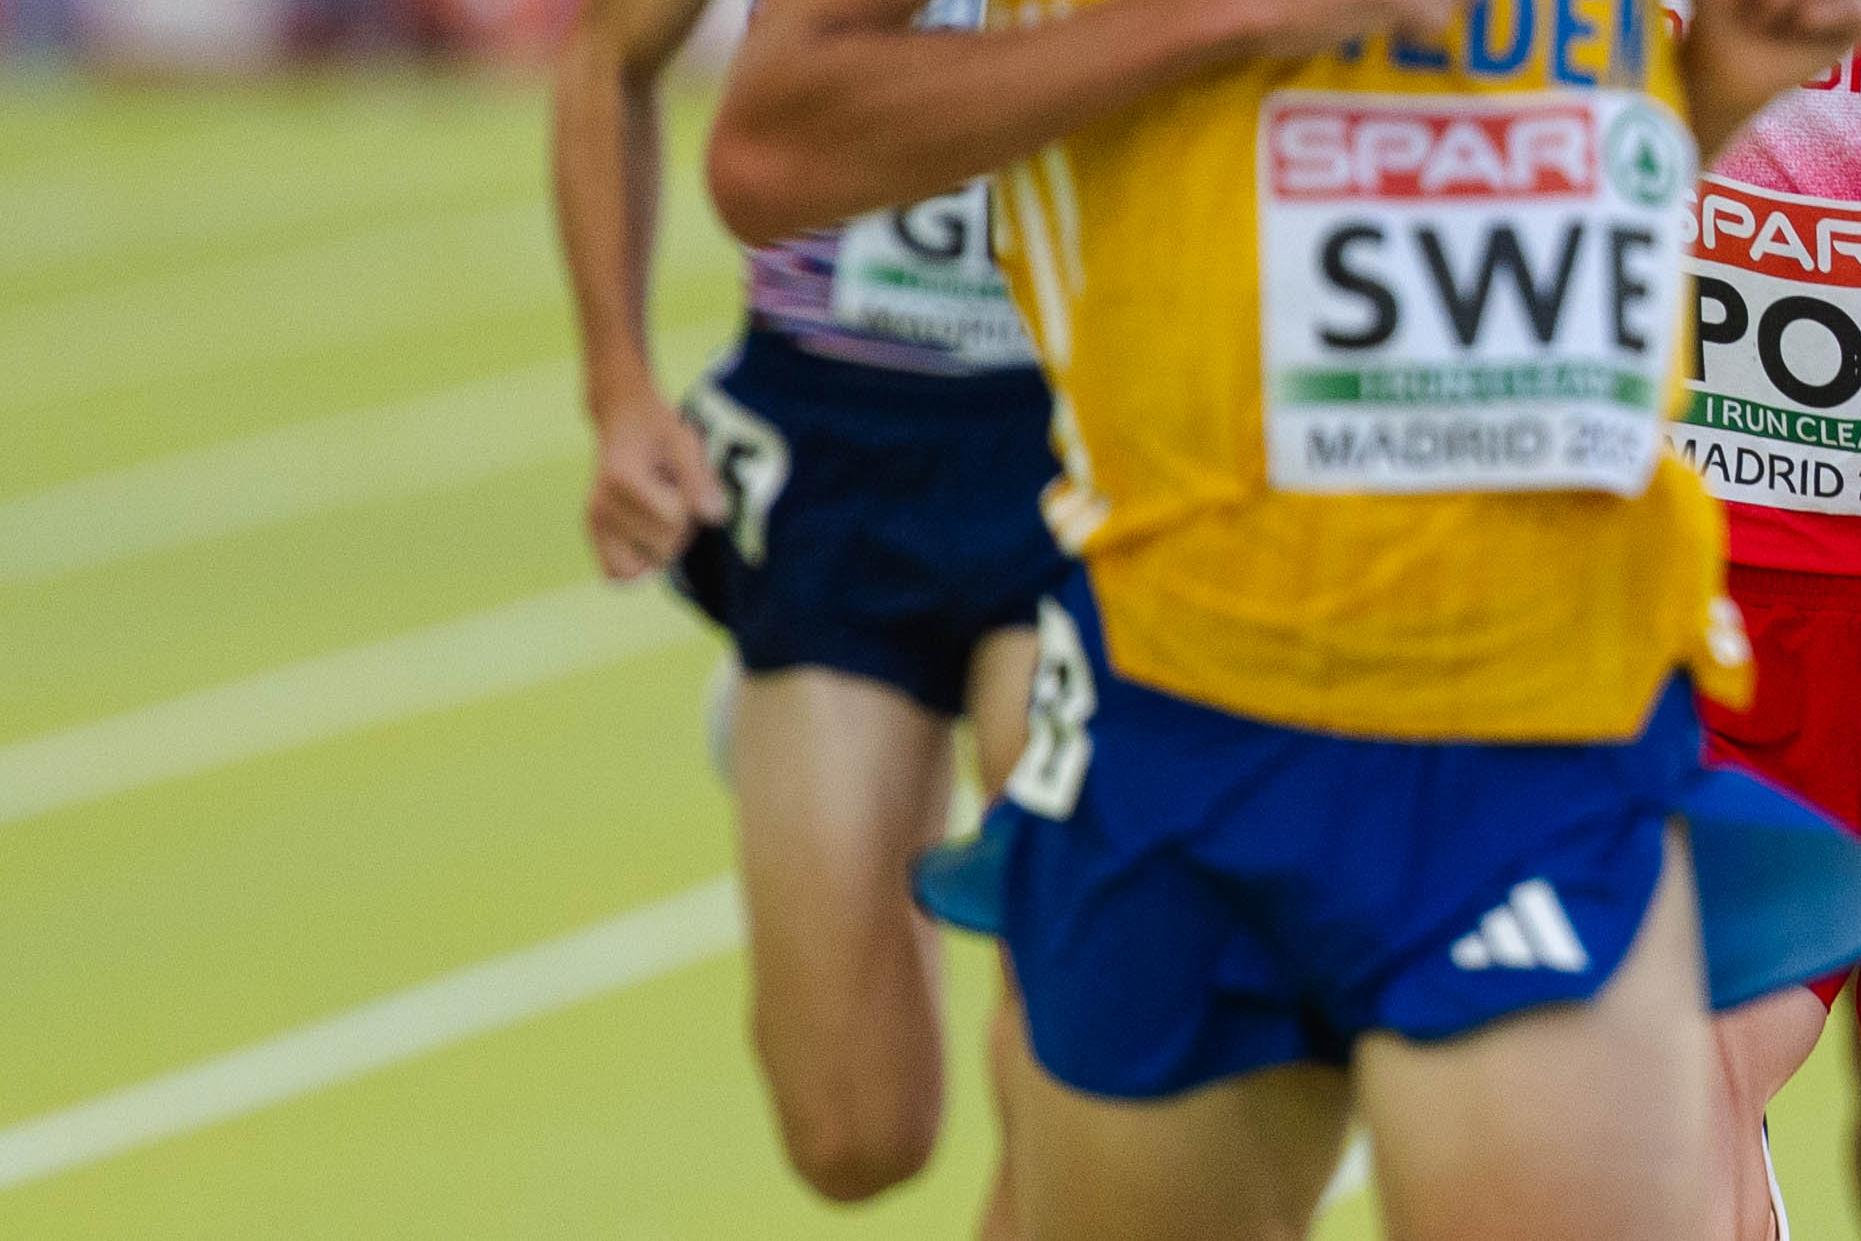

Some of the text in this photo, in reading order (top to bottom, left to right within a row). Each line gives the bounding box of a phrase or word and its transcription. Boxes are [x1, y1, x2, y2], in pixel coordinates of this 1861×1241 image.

[1280, 116, 1586, 191] SPAR
[1317, 217, 1654, 351] SWE
[1721, 400, 1788, 438] RUN
